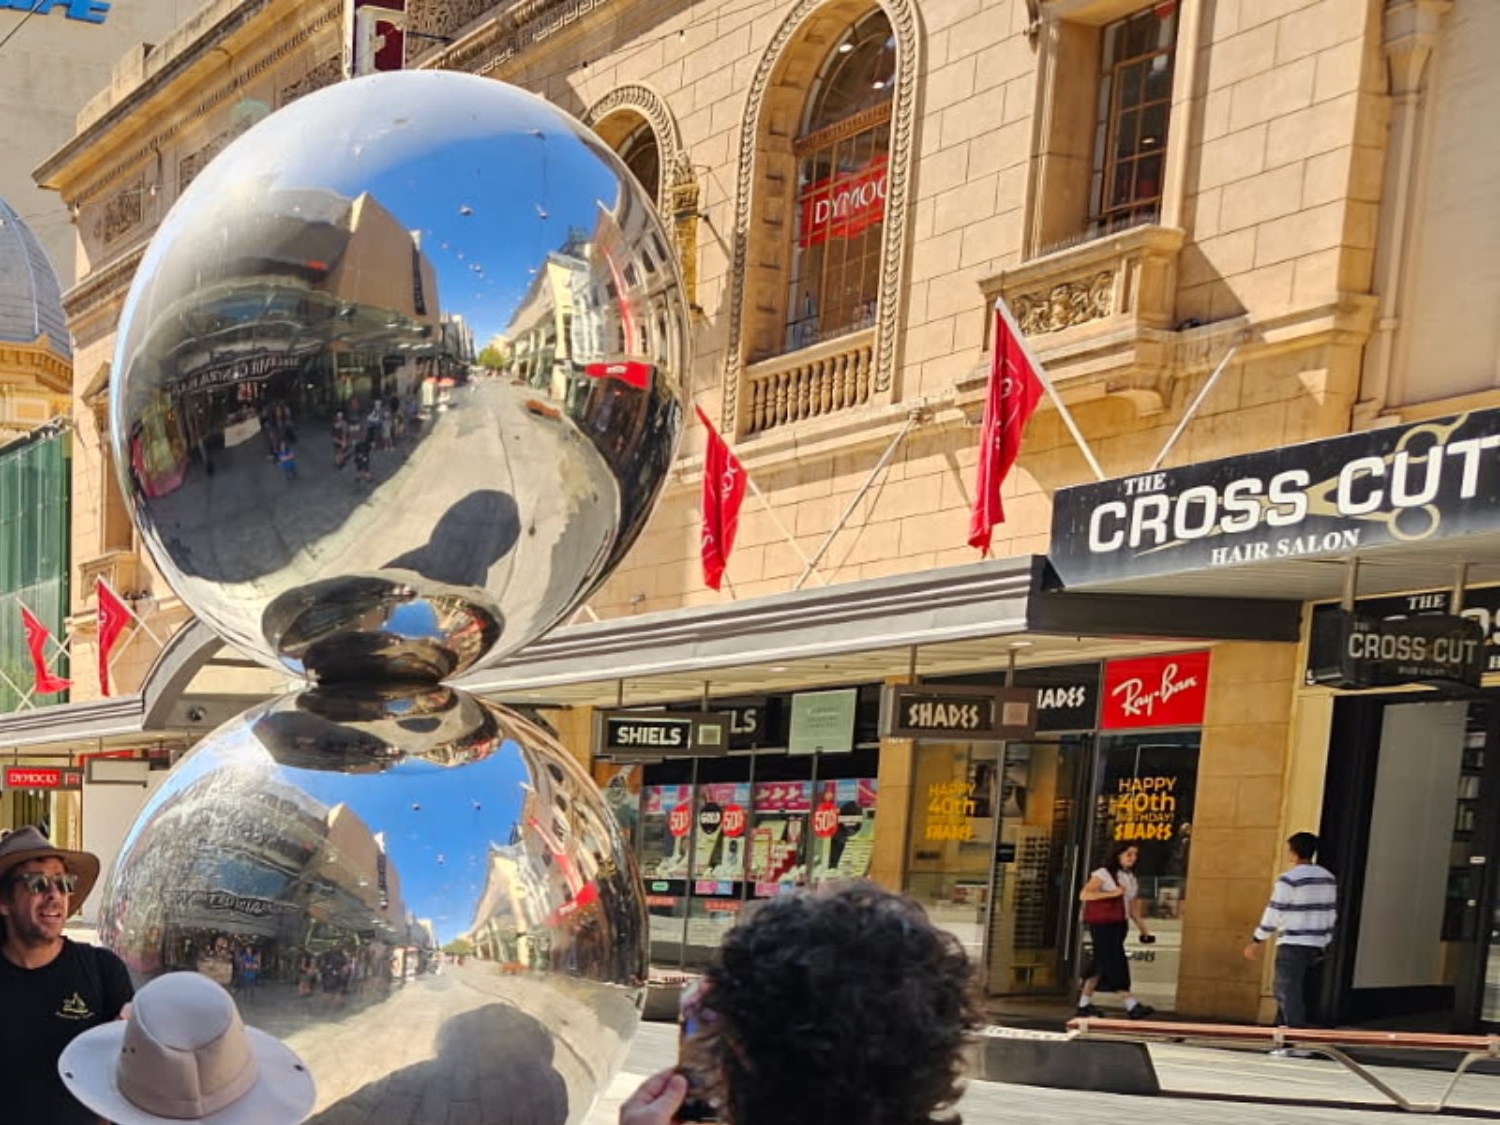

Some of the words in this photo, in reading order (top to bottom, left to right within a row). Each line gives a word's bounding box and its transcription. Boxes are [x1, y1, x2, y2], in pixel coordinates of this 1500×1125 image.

[1088, 469, 1310, 554] CROSS
[1337, 434, 1500, 516] CUT
[1123, 473, 1167, 496] THE
[1211, 541, 1269, 566] HAIR
[1274, 528, 1361, 557] SALON
[1408, 594, 1445, 610] THE
[1348, 633, 1427, 661] CROSS
[1433, 637, 1478, 664] CUT
[1112, 663, 1197, 717] Ray-Ban
[721, 709, 757, 733] LS
[908, 702, 979, 729] SHADES
[617, 727, 681, 745] SHIELS
[1119, 776, 1178, 792] HAPPY
[1116, 792, 1176, 813] 40th
[1114, 823, 1172, 840] SHADES
